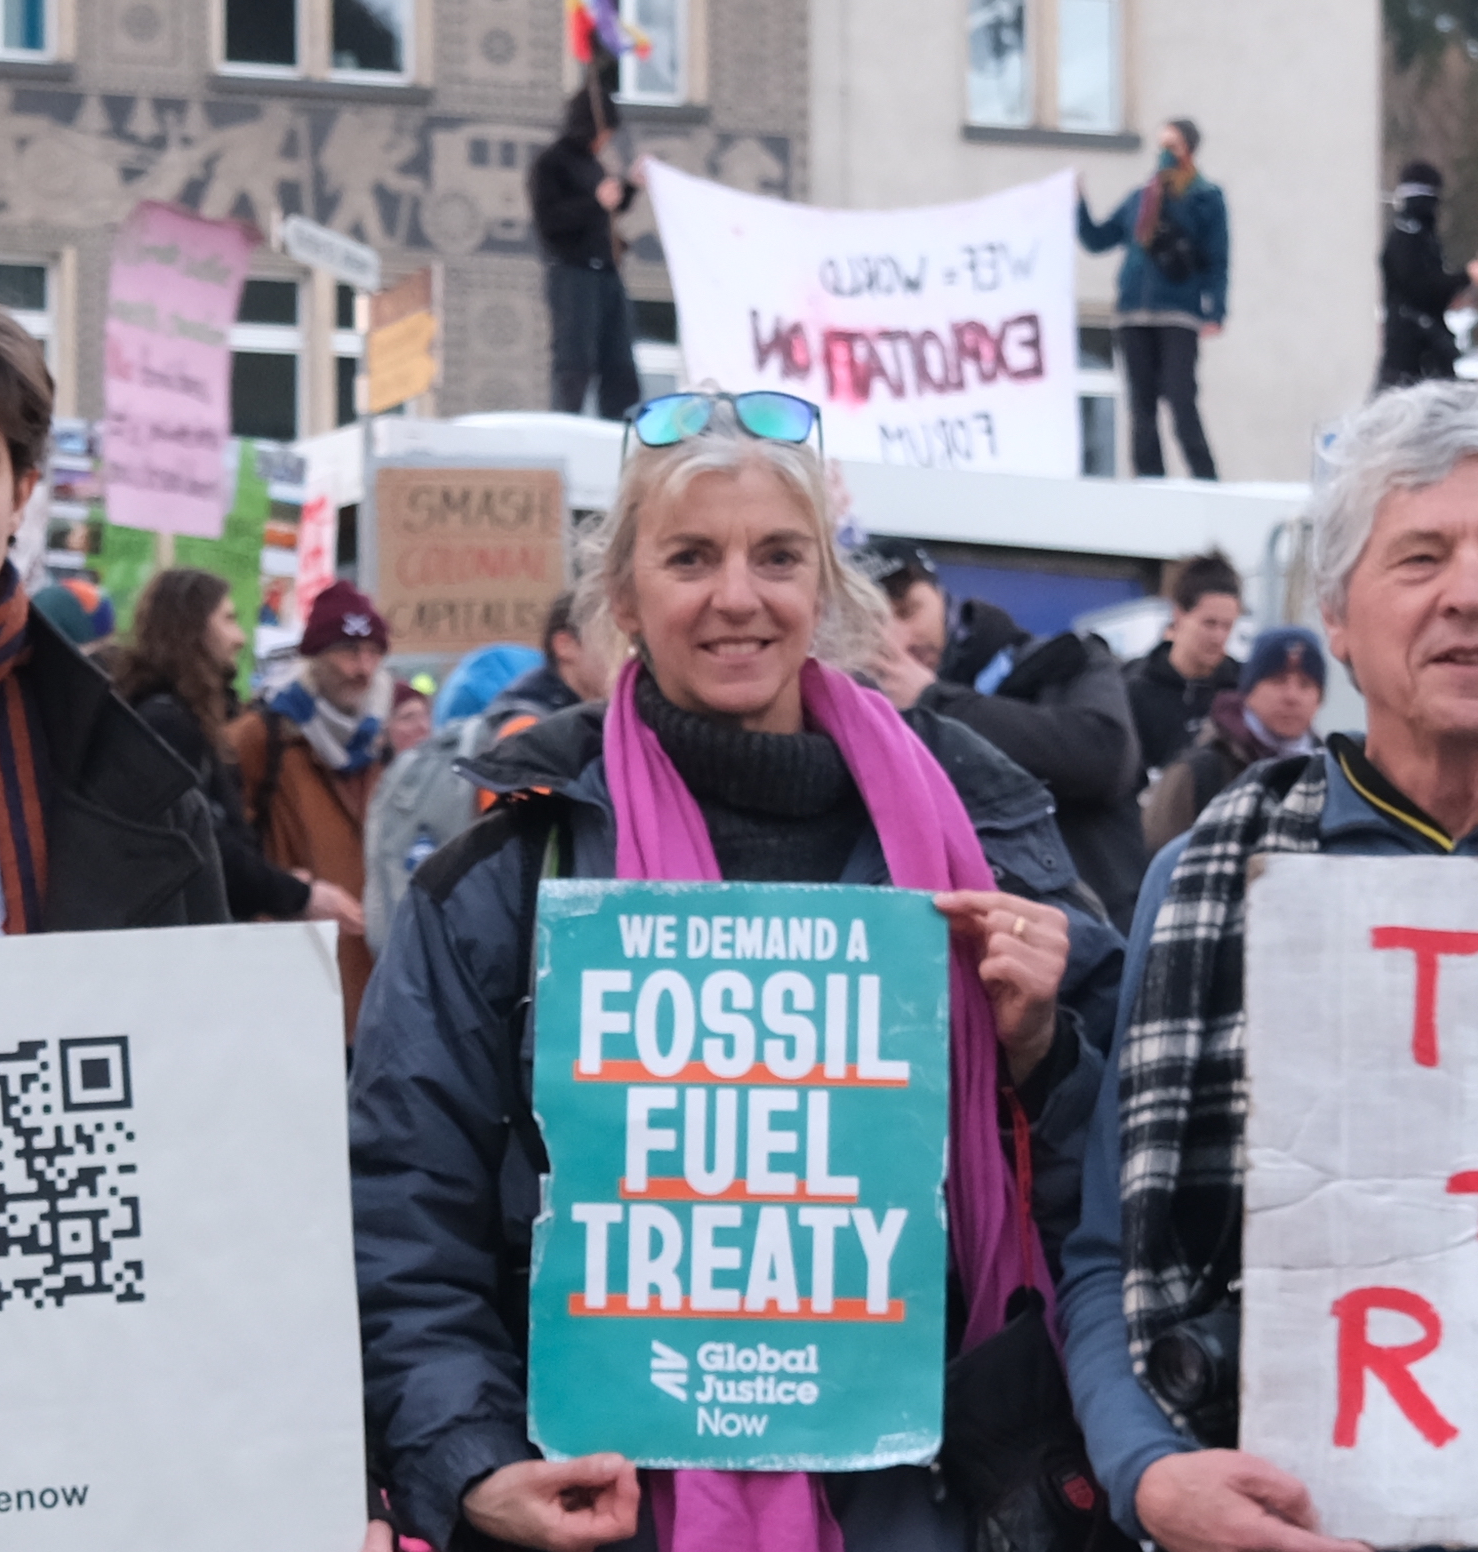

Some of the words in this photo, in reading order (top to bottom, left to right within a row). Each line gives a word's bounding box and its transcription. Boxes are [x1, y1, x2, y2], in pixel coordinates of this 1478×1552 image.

[403, 483, 559, 536] SMASH
[387, 597, 547, 640] CAPITALIS
[619, 914, 677, 958] WE
[687, 916, 838, 961] DEMAND
[846, 918, 870, 962] A
[579, 970, 910, 1080] FOSSIL
[625, 1087, 859, 1196] FUEL
[571, 1203, 908, 1315] TREATY
[696, 1342, 819, 1374] Global
[695, 1375, 819, 1404] Justice
[697, 1407, 768, 1437] Now
